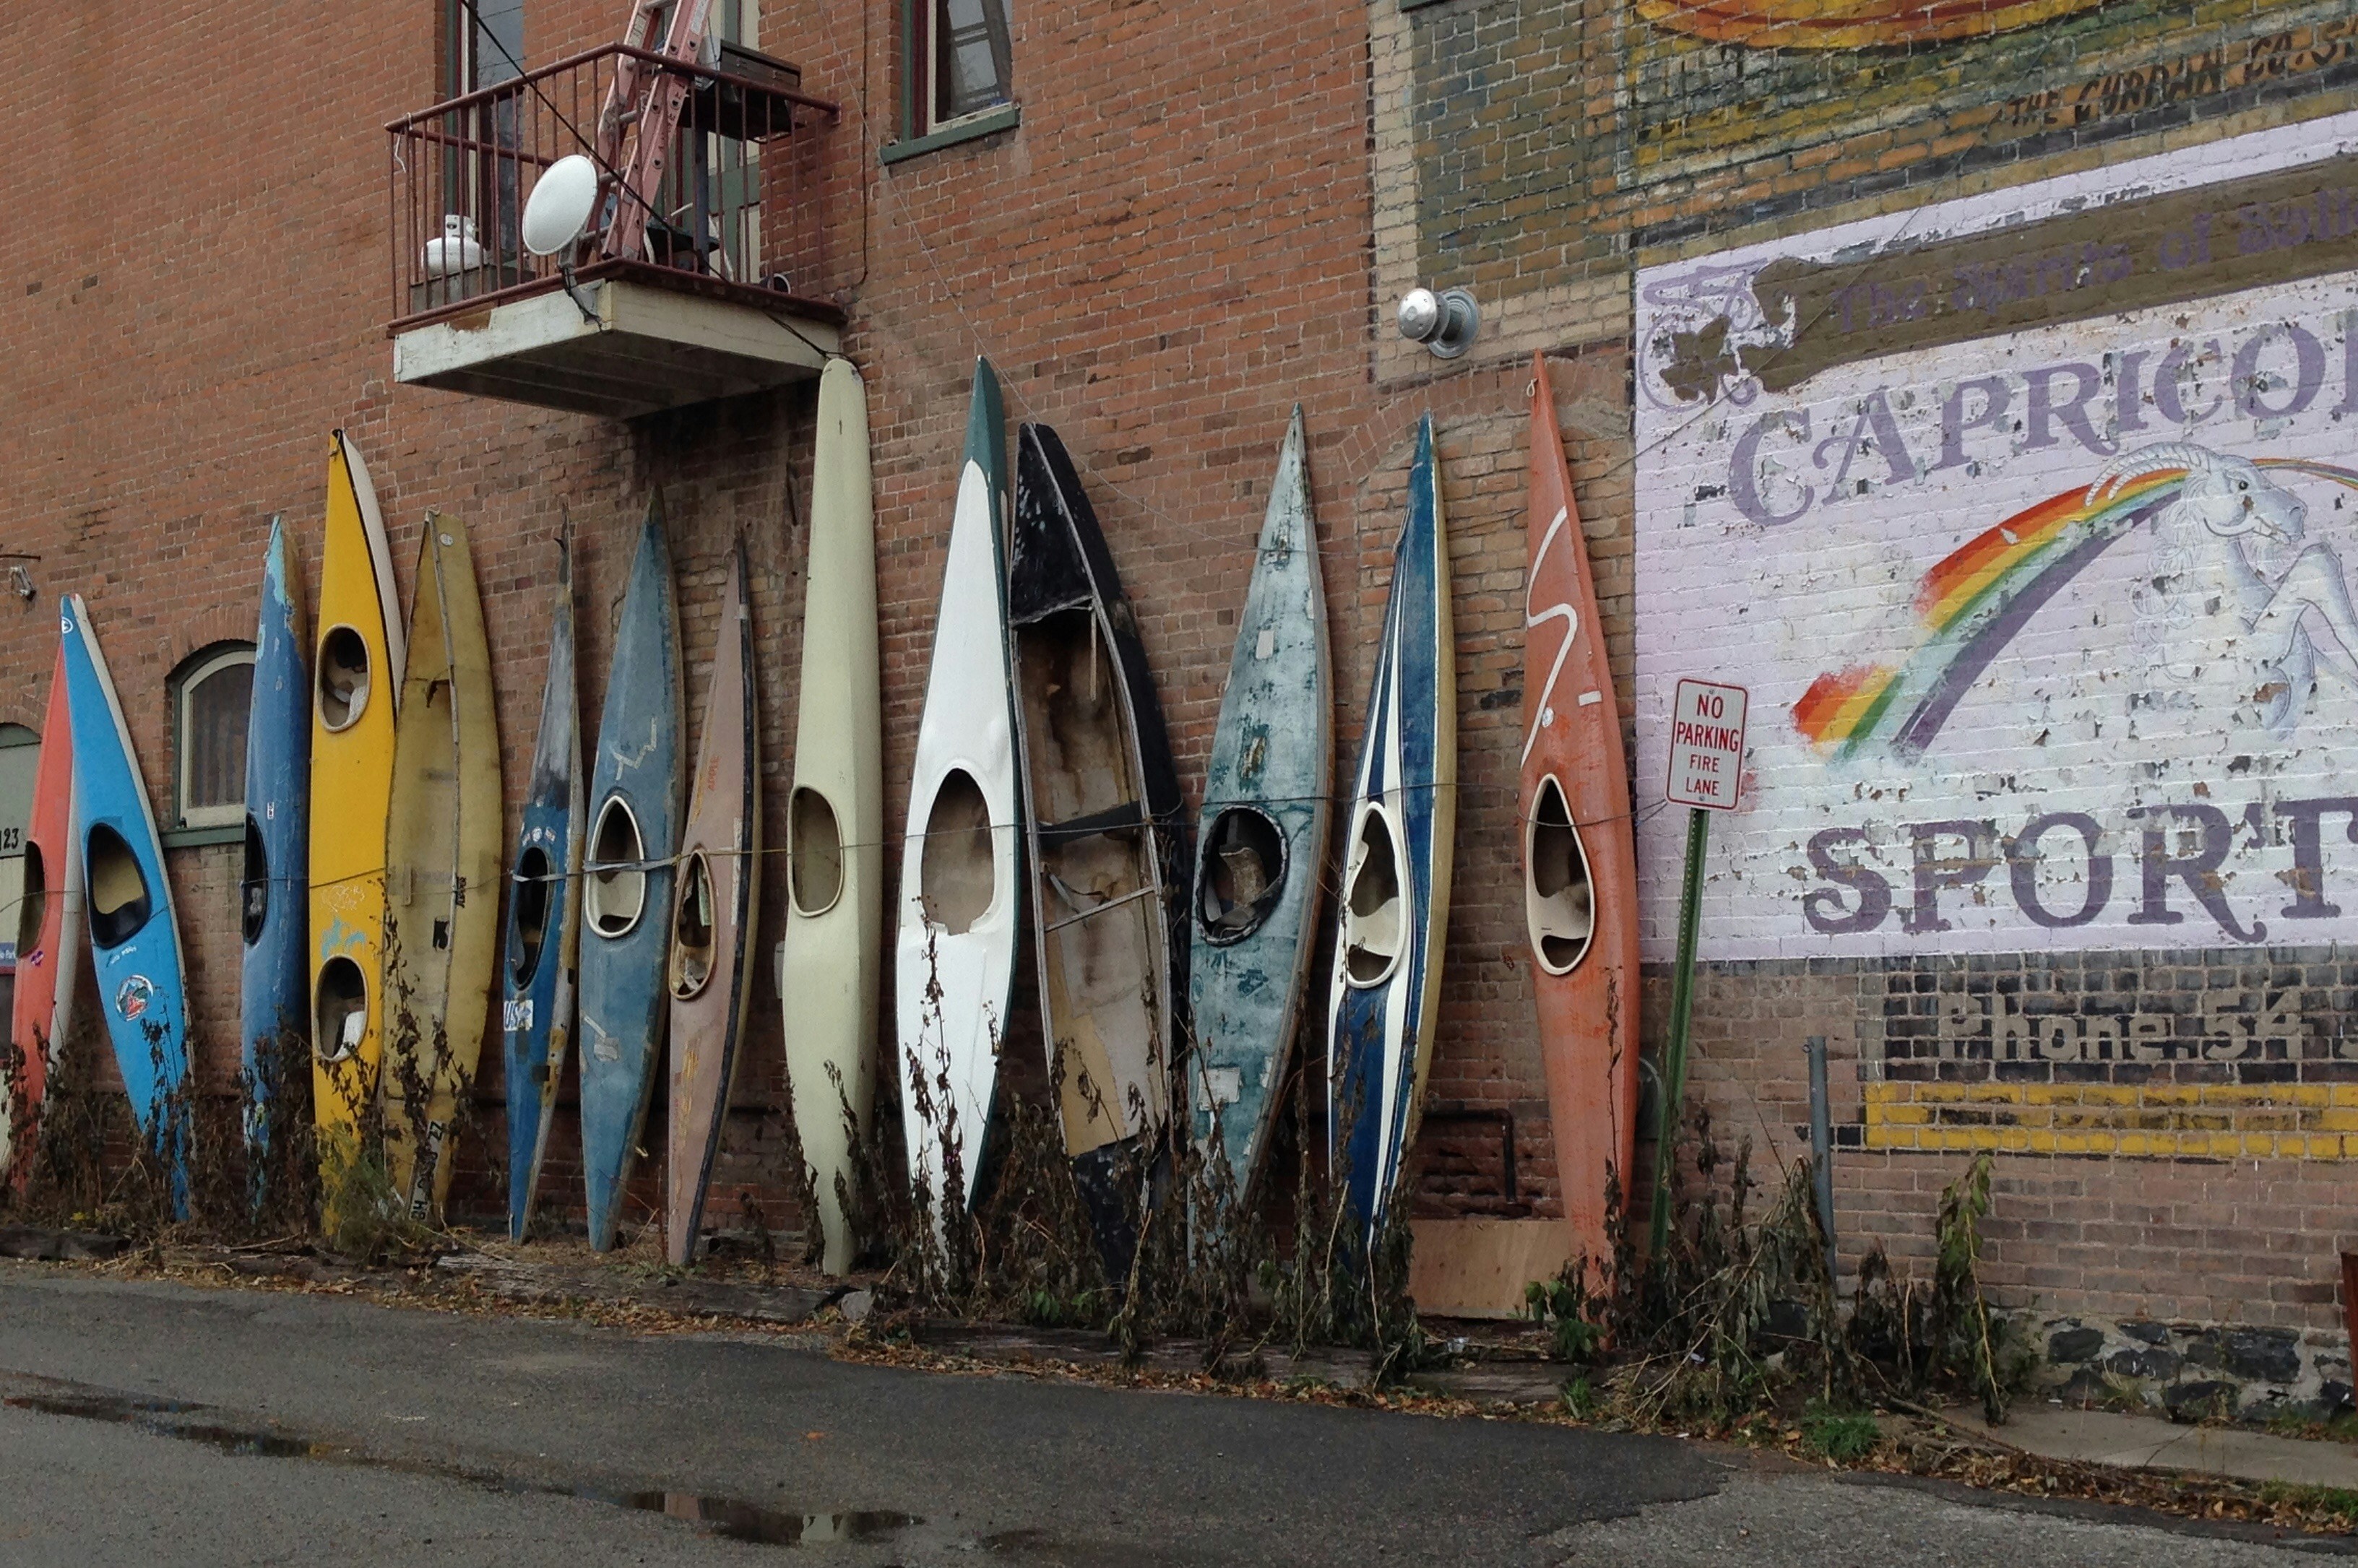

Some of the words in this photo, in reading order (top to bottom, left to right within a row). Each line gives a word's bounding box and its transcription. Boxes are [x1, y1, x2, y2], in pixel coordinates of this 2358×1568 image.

[2007, 90, 2059, 126] THE
[2075, 49, 2224, 121] CURRAN
[1829, 280, 1927, 334] The
[2158, 212, 2214, 271] of
[1696, 693, 1724, 719] NO
[1675, 721, 1740, 753] PARKING
[1689, 753, 1720, 773] FIRE
[1685, 776, 1719, 796] LANE
